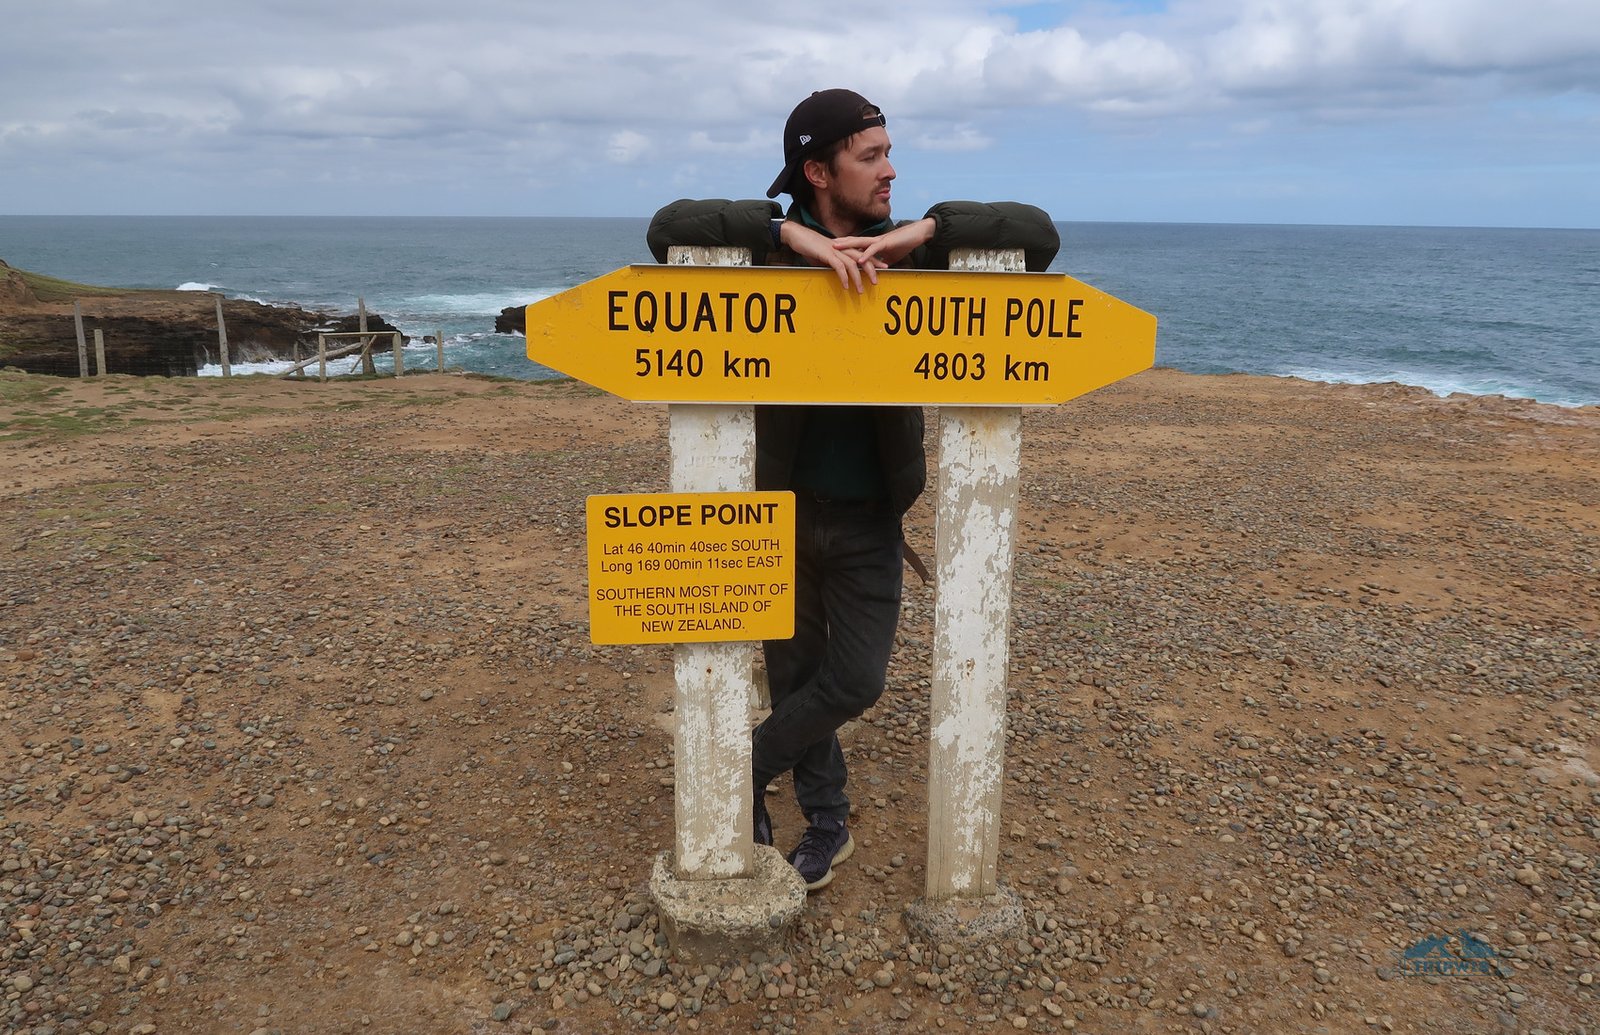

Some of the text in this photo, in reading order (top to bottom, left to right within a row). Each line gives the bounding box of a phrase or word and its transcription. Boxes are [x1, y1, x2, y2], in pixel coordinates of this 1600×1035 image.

[608, 290, 797, 334] EQUATOR
[884, 294, 1084, 338] SOUTH POLE
[636, 348, 771, 378] 5140 km
[913, 352, 1049, 382] 4803 km
[604, 502, 779, 529] SLOPE POINT
[603, 538, 780, 555] Lat 46 40min 40sec SOUTH
[601, 555, 784, 575] Long 169 00min 11sec EAST
[596, 583, 789, 601] SOUTHERN MOST POINT OF
[613, 600, 772, 617] THE SOUTH ISLAND OF
[641, 617, 745, 633] NEW ZEALAND.
